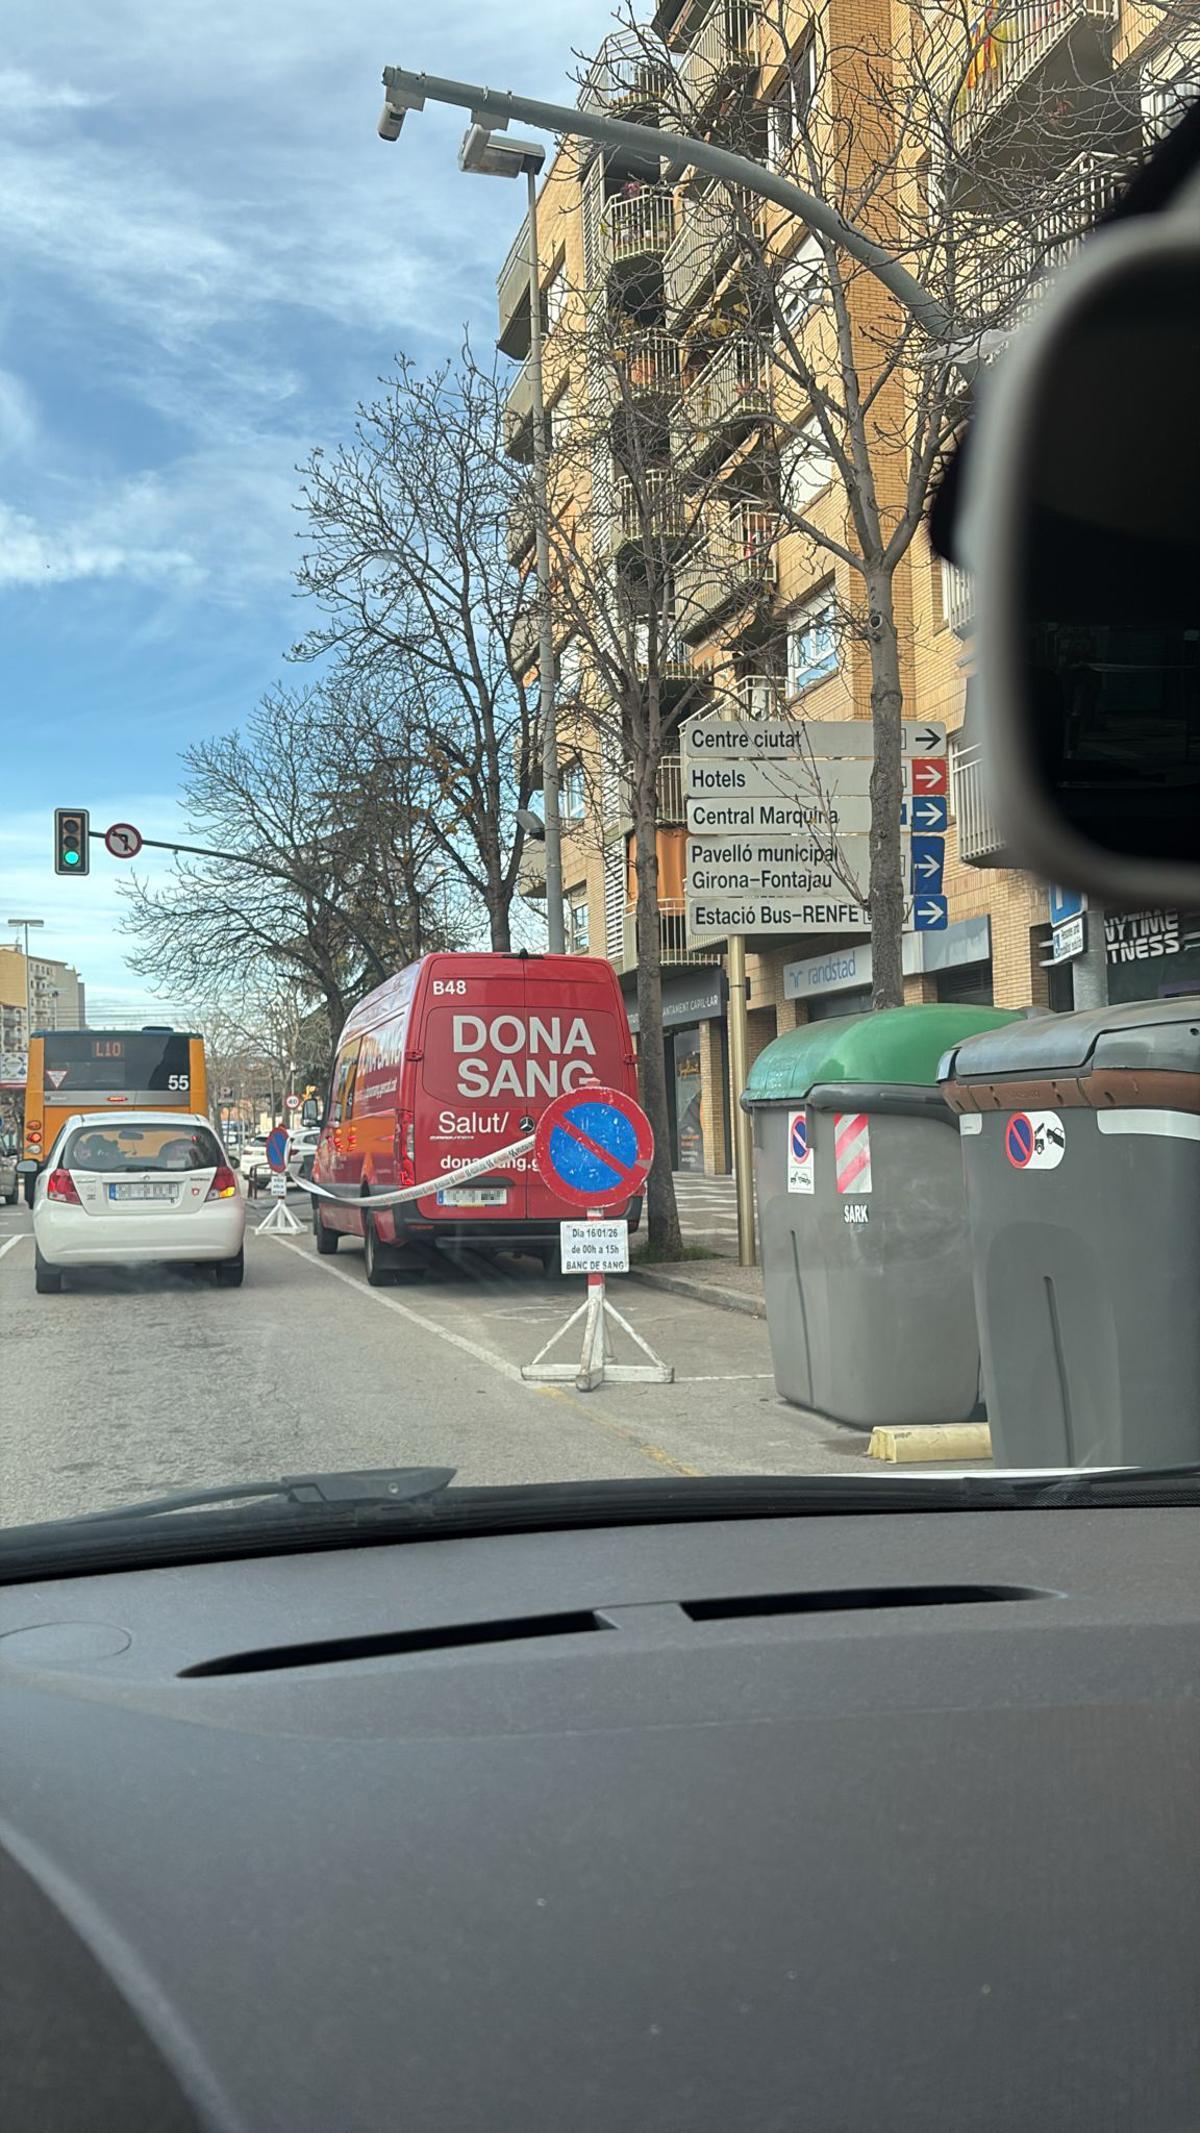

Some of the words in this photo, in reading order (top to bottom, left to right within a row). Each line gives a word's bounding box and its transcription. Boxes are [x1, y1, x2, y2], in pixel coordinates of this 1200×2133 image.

[691, 729, 749, 747] Centre
[754, 731, 801, 747] ciutat
[691, 769, 746, 788] Hotels
[693, 806, 754, 825] Central
[760, 806, 839, 828] Marquina
[691, 844, 751, 863] Pavelló
[758, 845, 838, 865] municipal
[692, 869, 832, 892] Girona-Fontajau
[695, 905, 755, 925] Estació
[761, 904, 859, 924] Bus-RENFE
[1104, 909, 1178, 942] NYTIME
[1105, 931, 1179, 964] TNESS
[807, 950, 856, 985] randstad
[433, 980, 467, 995] B48
[452, 1014, 596, 1056] DONA
[95, 1042, 121, 1057] L10
[168, 1075, 189, 1090] 55
[457, 1058, 595, 1099] SANG
[844, 1204, 869, 1223] SARK
[572, 1228, 585, 1238] Dia
[571, 1245, 581, 1254] de
[582, 1245, 597, 1254] 00h
[605, 1245, 619, 1254] 15h
[566, 1261, 588, 1270] BANC
[590, 1261, 601, 1270] DE
[602, 1261, 624, 1270] SANG
